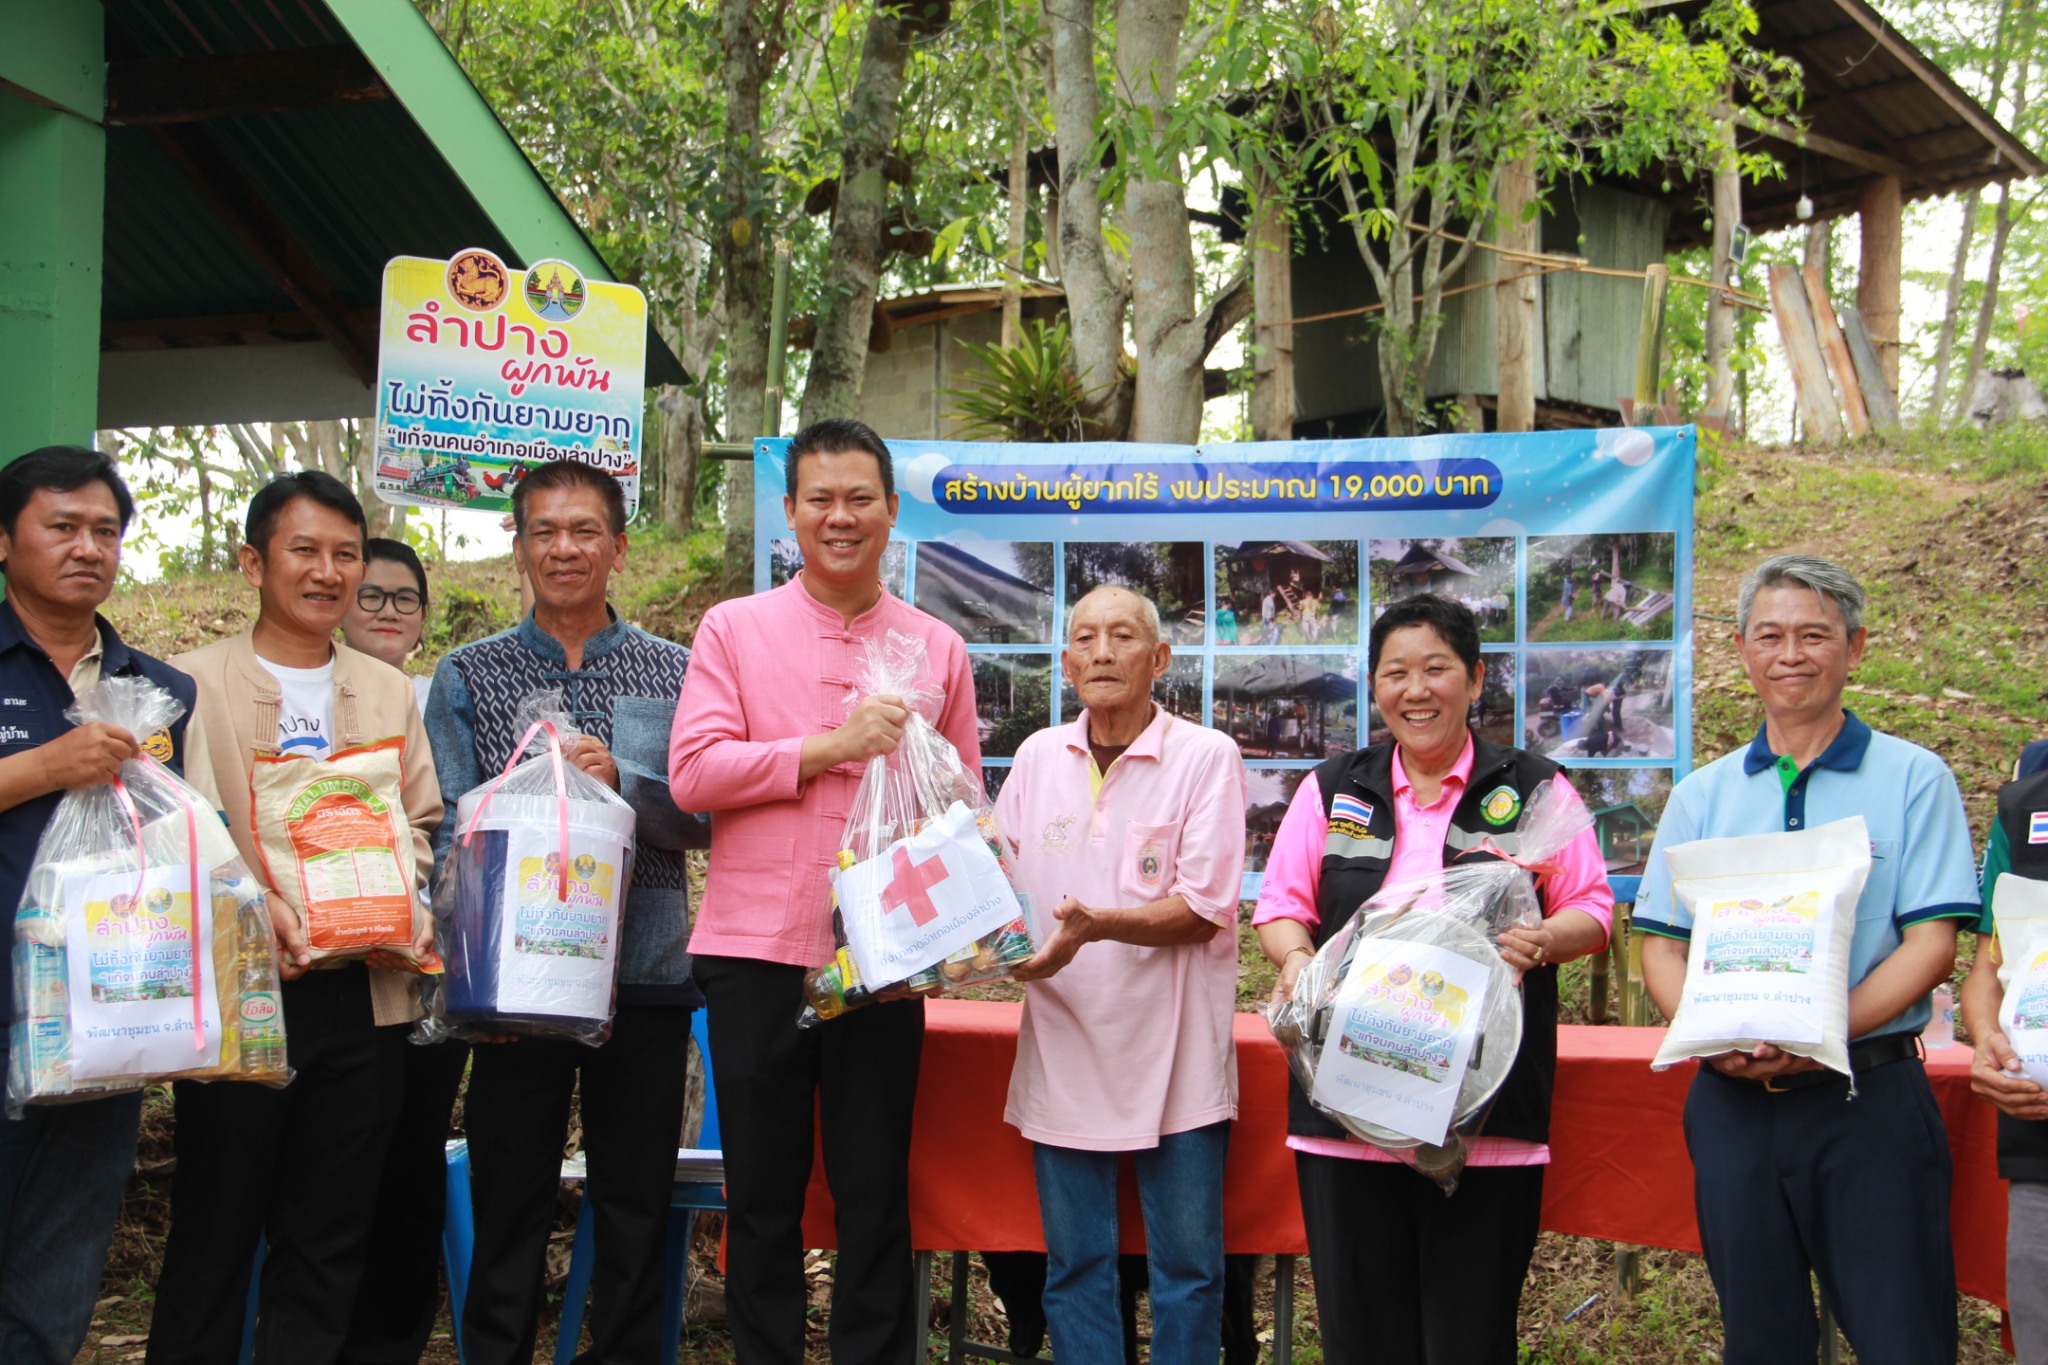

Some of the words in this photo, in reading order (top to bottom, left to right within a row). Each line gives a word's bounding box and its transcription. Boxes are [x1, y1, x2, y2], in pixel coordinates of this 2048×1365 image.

[407, 301, 569, 359] ลำปาง
[501, 356, 611, 396] ผูกพัน
[388, 379, 631, 439] ไม่ทิ้งกันยามยาก
[944, 472, 1159, 511] สร้างบ้านผู้ยากไร้
[1169, 472, 1317, 500] งบประมาณ
[1329, 474, 1424, 501] 19,000
[1434, 474, 1489, 496] บาท
[290, 789, 318, 818] OYAL
[317, 780, 384, 811] UMBRELA
[96, 916, 169, 936] ลำปาง
[1709, 927, 1811, 945] ไม่ทิ้งกันยามยาก
[1366, 979, 1433, 1011] ลำปาง
[163, 1018, 209, 1033] จ.ลำง
[1351, 1007, 1453, 1050] ไม่ทิ้งกันยามยาก
